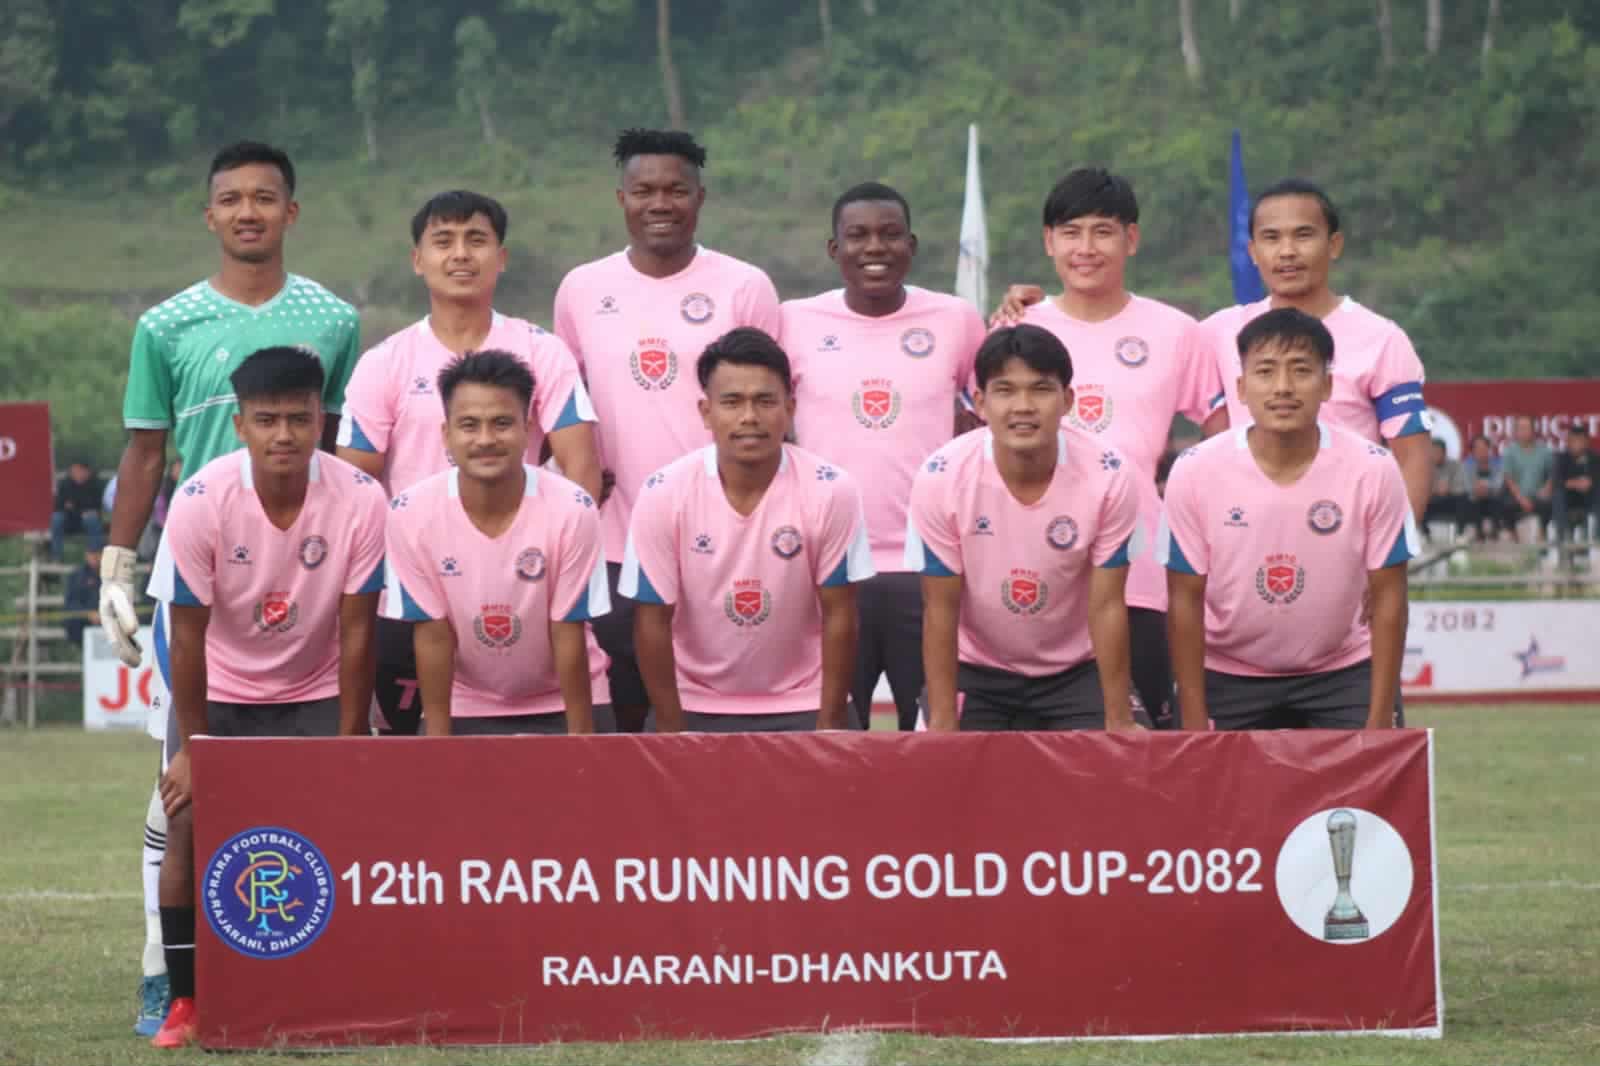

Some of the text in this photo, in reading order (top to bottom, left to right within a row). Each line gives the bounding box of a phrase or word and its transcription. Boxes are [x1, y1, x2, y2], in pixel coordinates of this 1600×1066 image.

[1426, 608, 1495, 632] 2082
[209, 833, 328, 888] RARA FOOTBALL CLUB
[341, 847, 1263, 906] 12th RARA RUNNING GOLD CUP-2082
[211, 898, 327, 952] RAJARANI, DHANKUTA
[542, 949, 1007, 986] RAJARANI-DHANKUTA
